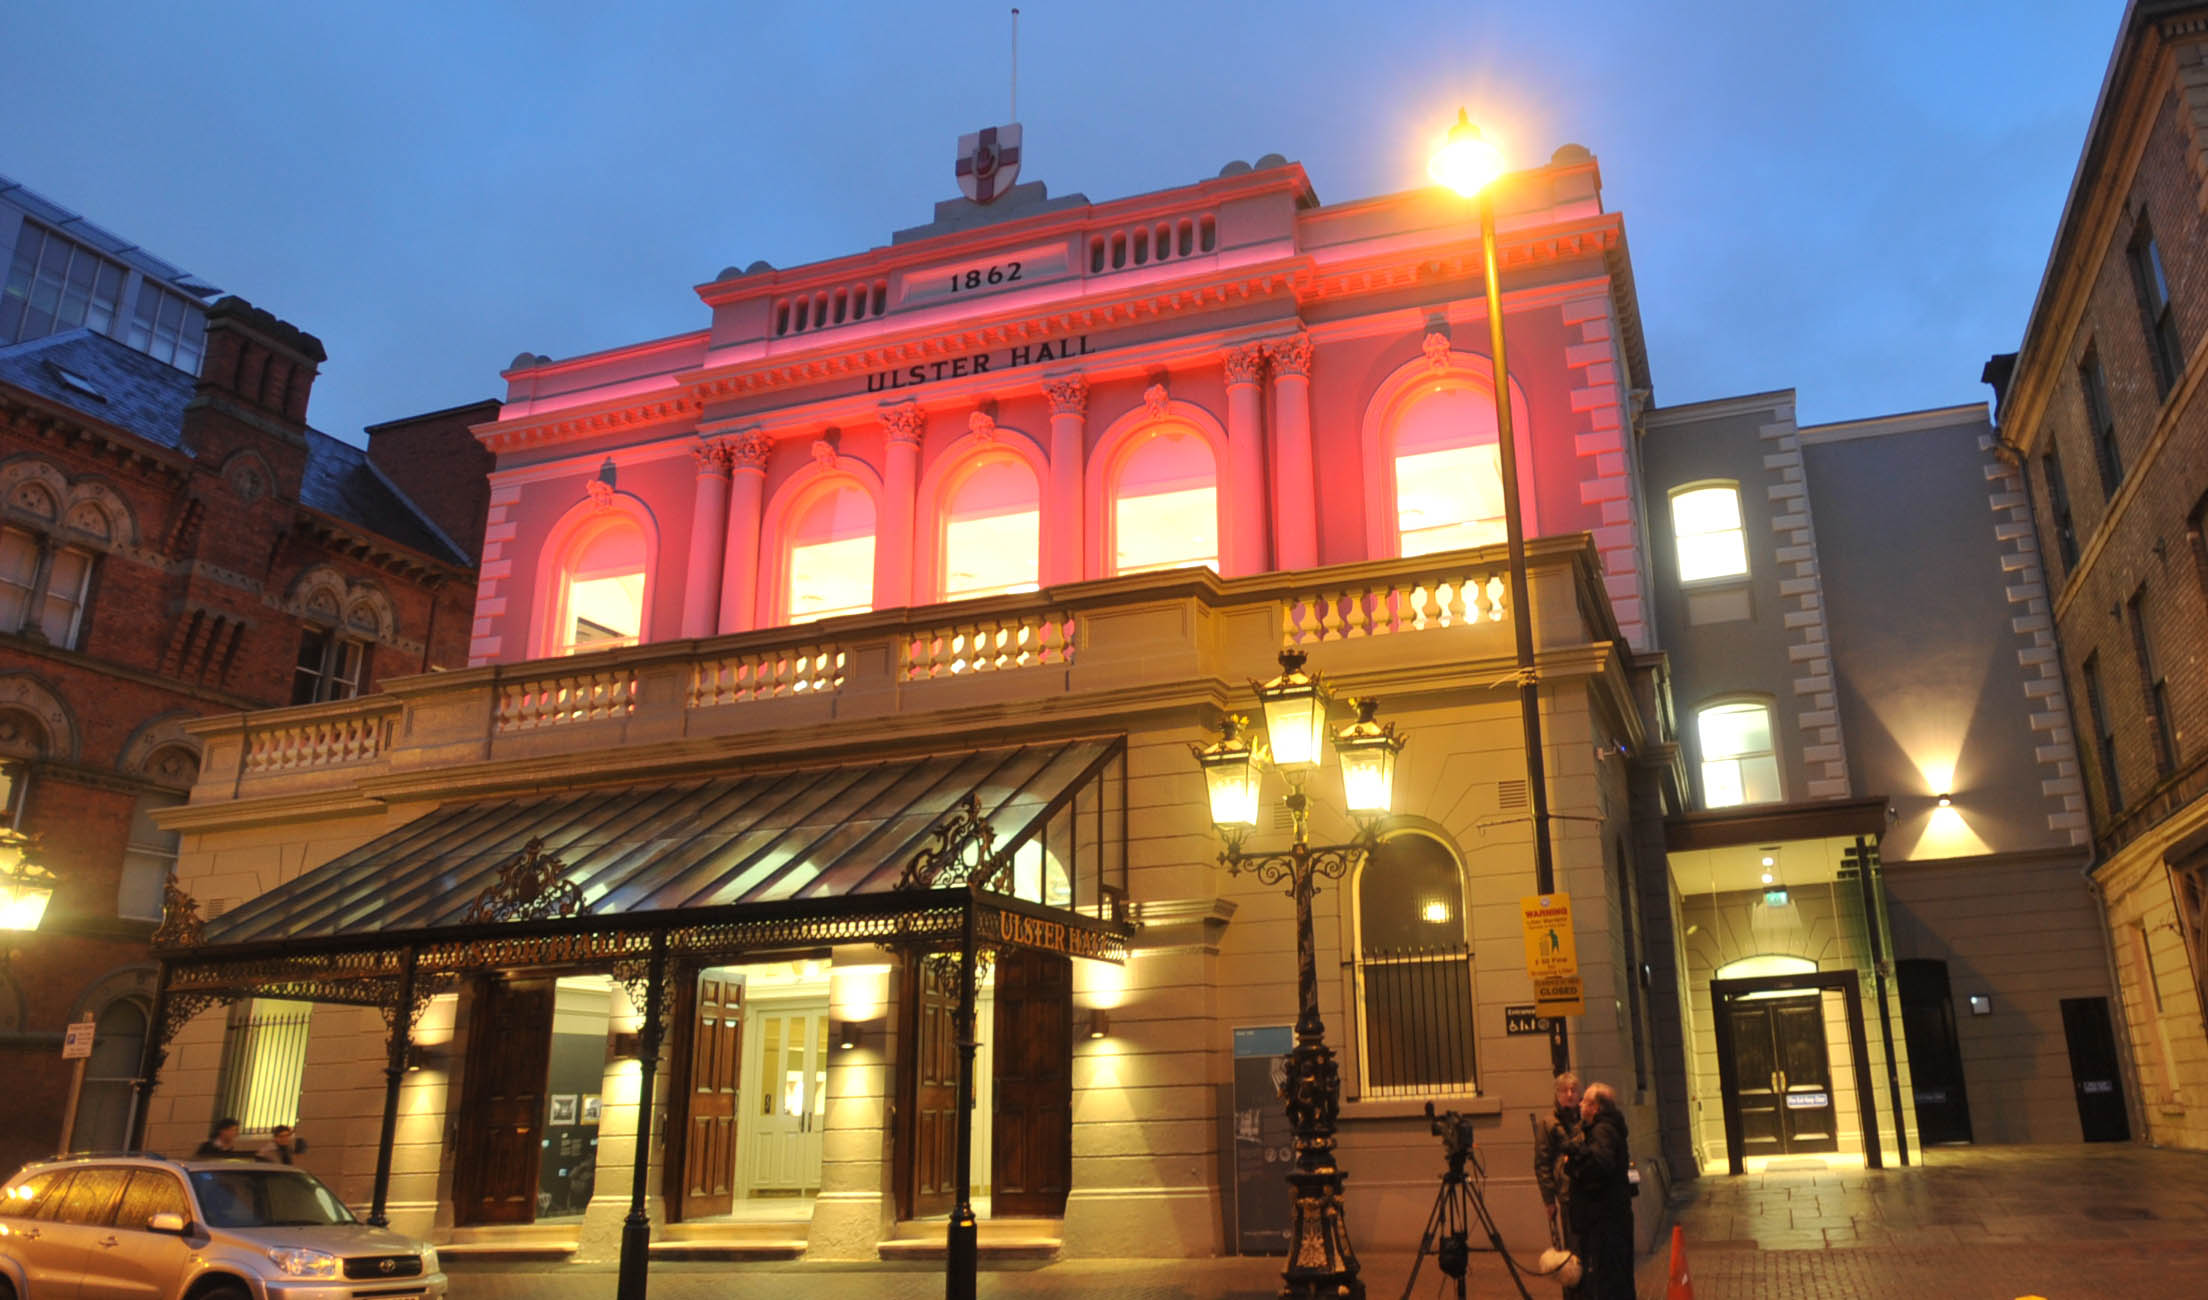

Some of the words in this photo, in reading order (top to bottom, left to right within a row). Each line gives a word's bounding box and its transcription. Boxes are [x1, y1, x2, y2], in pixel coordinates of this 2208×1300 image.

[951, 262, 1023, 293] 1862
[867, 353, 991, 393] ULSTER
[1010, 335, 1096, 368] HALL
[1525, 907, 1568, 918] WARNING
[1000, 911, 1066, 952] ULSTER
[1068, 927, 1109, 958] HALL
[1540, 986, 1578, 996] CLOSED
